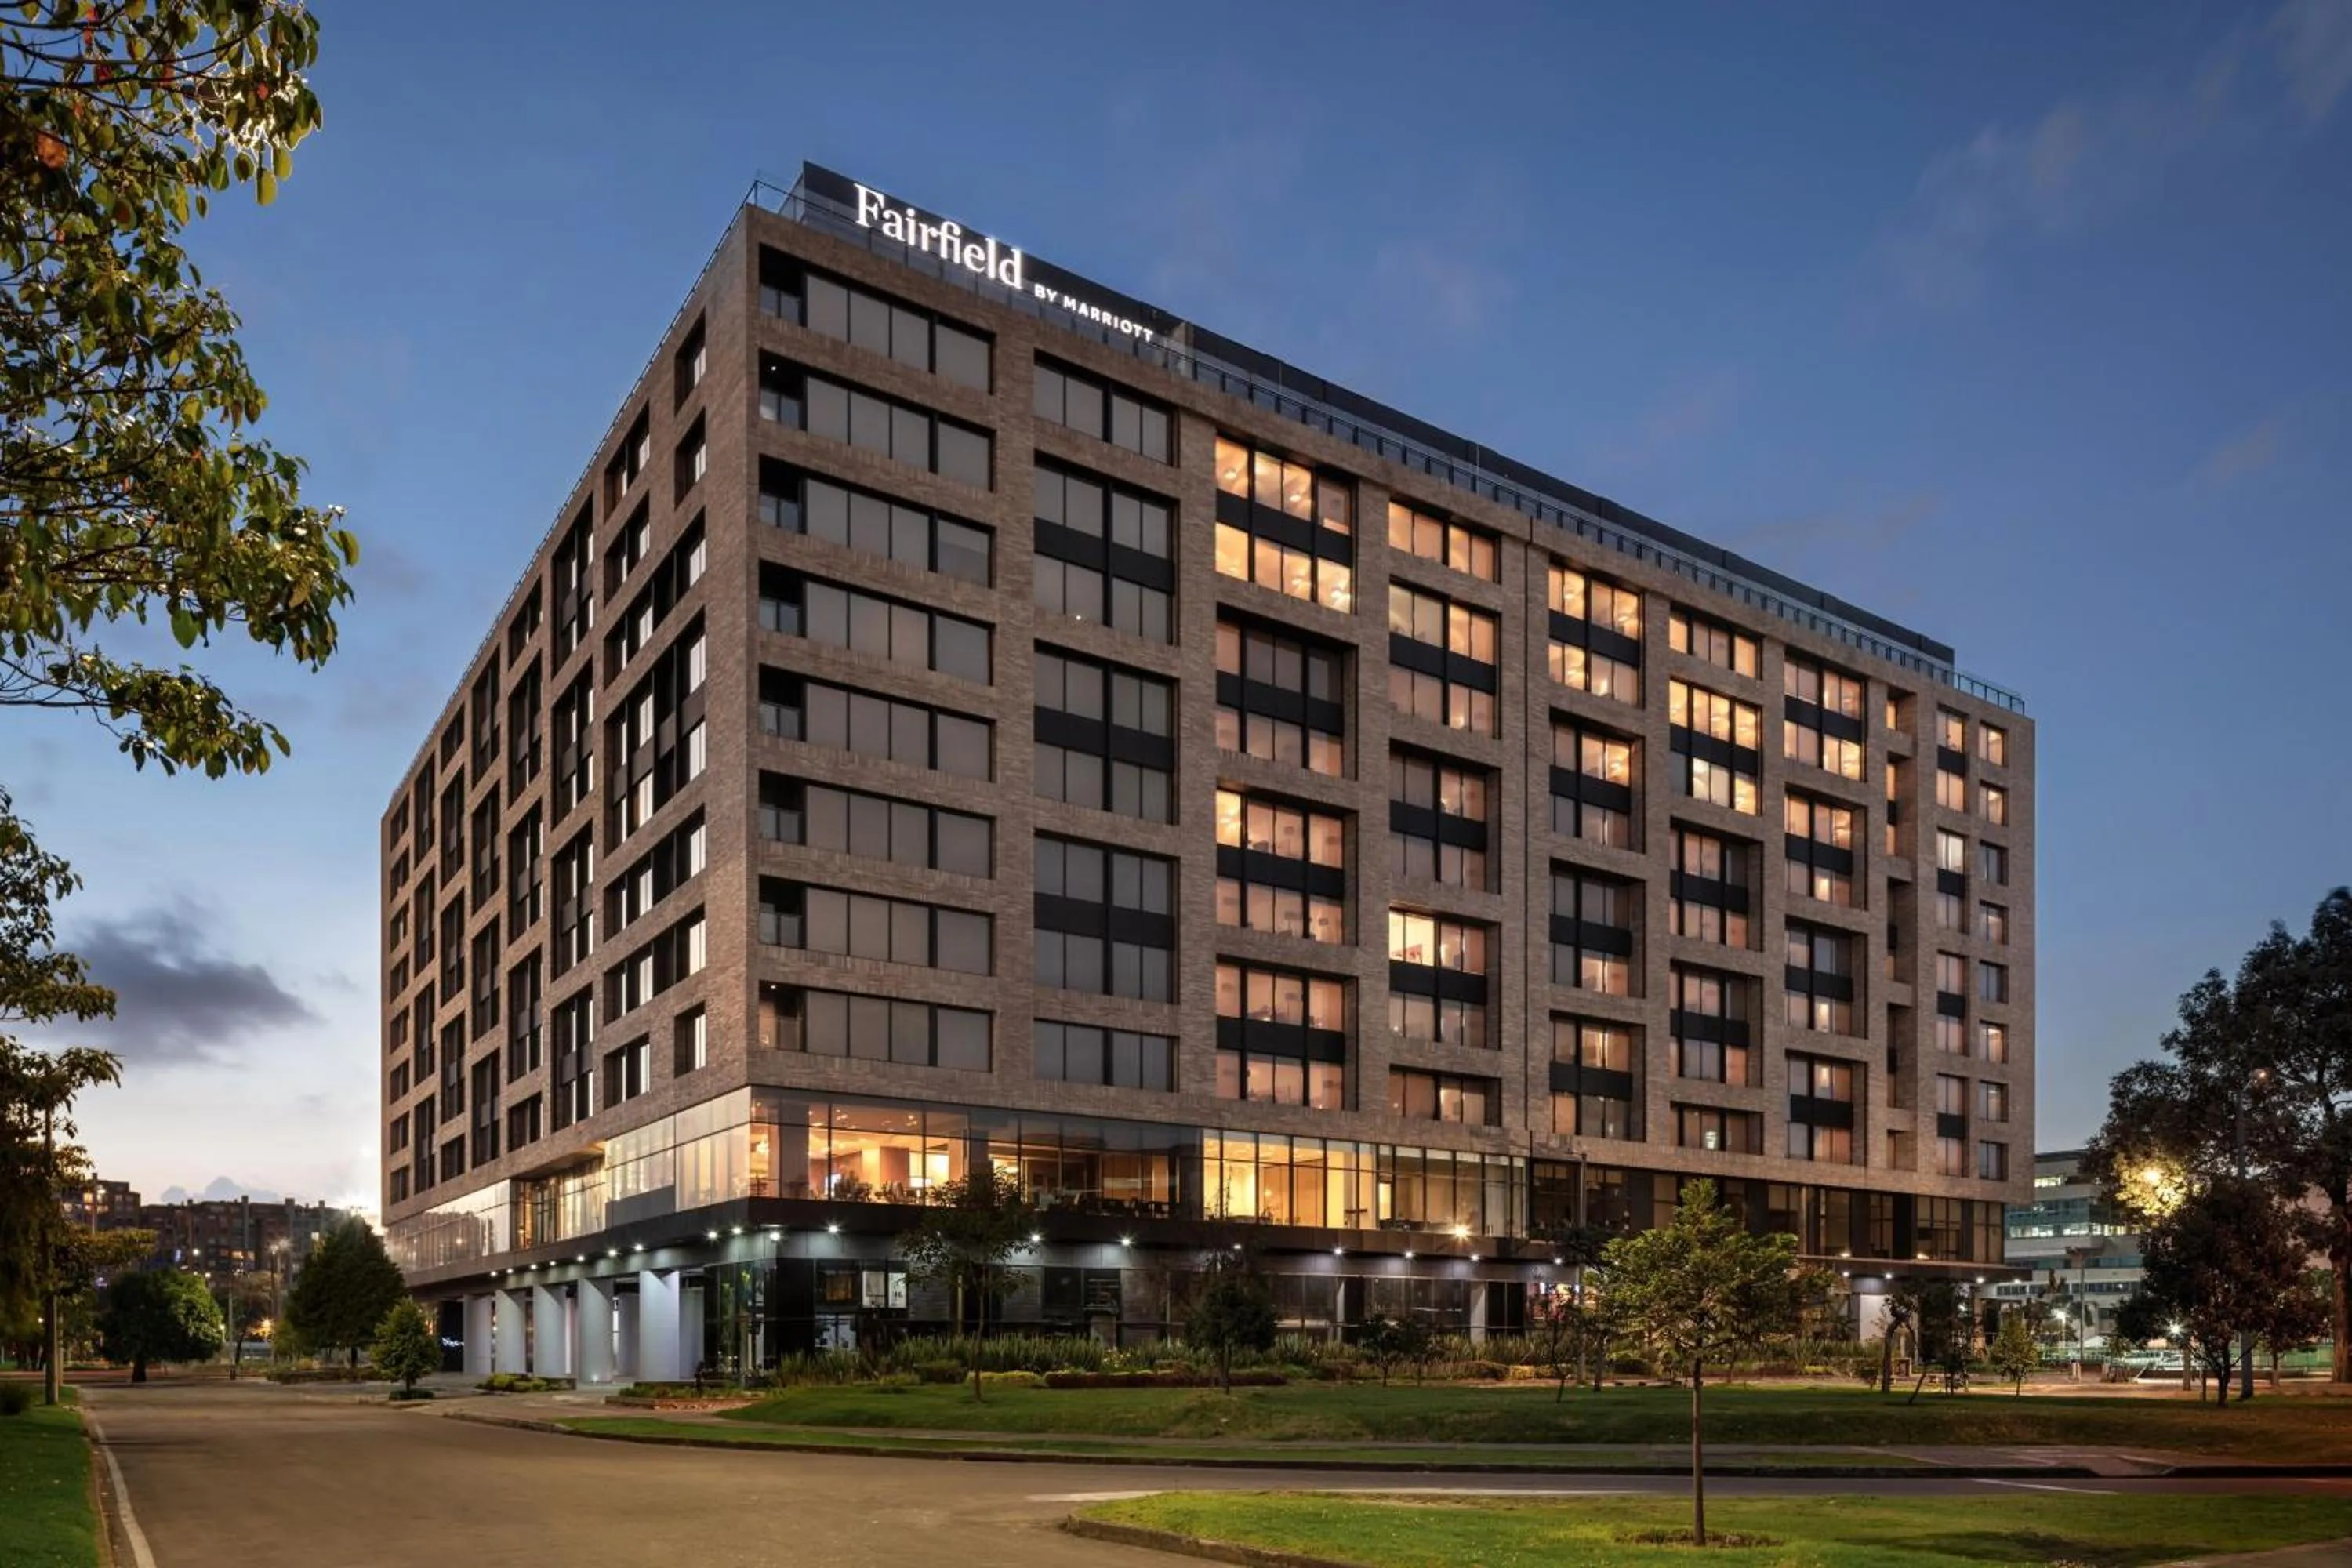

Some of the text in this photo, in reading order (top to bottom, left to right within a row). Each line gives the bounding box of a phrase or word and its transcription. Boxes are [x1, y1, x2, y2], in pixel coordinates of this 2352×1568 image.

[854, 183, 1154, 343] Fairfield BY MARRIOTT
